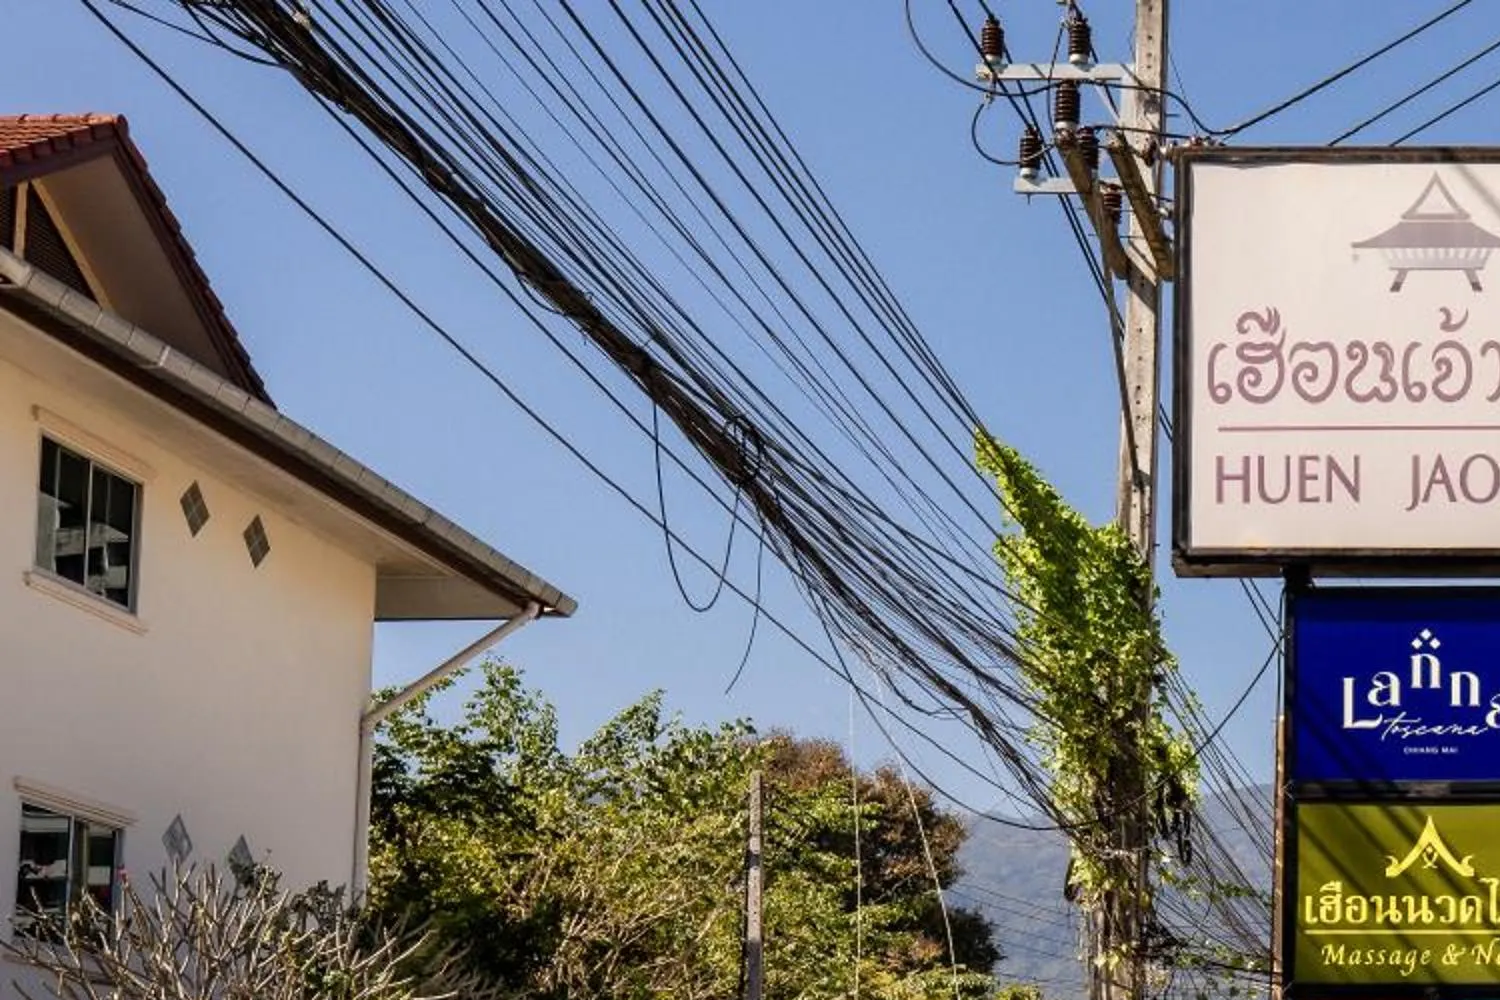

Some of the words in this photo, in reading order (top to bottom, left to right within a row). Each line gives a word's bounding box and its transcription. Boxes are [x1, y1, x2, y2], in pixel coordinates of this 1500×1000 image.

[1215, 453, 1361, 505] HUEN
[1321, 943, 1431, 977] Massage
[1441, 944, 1467, 966] &
